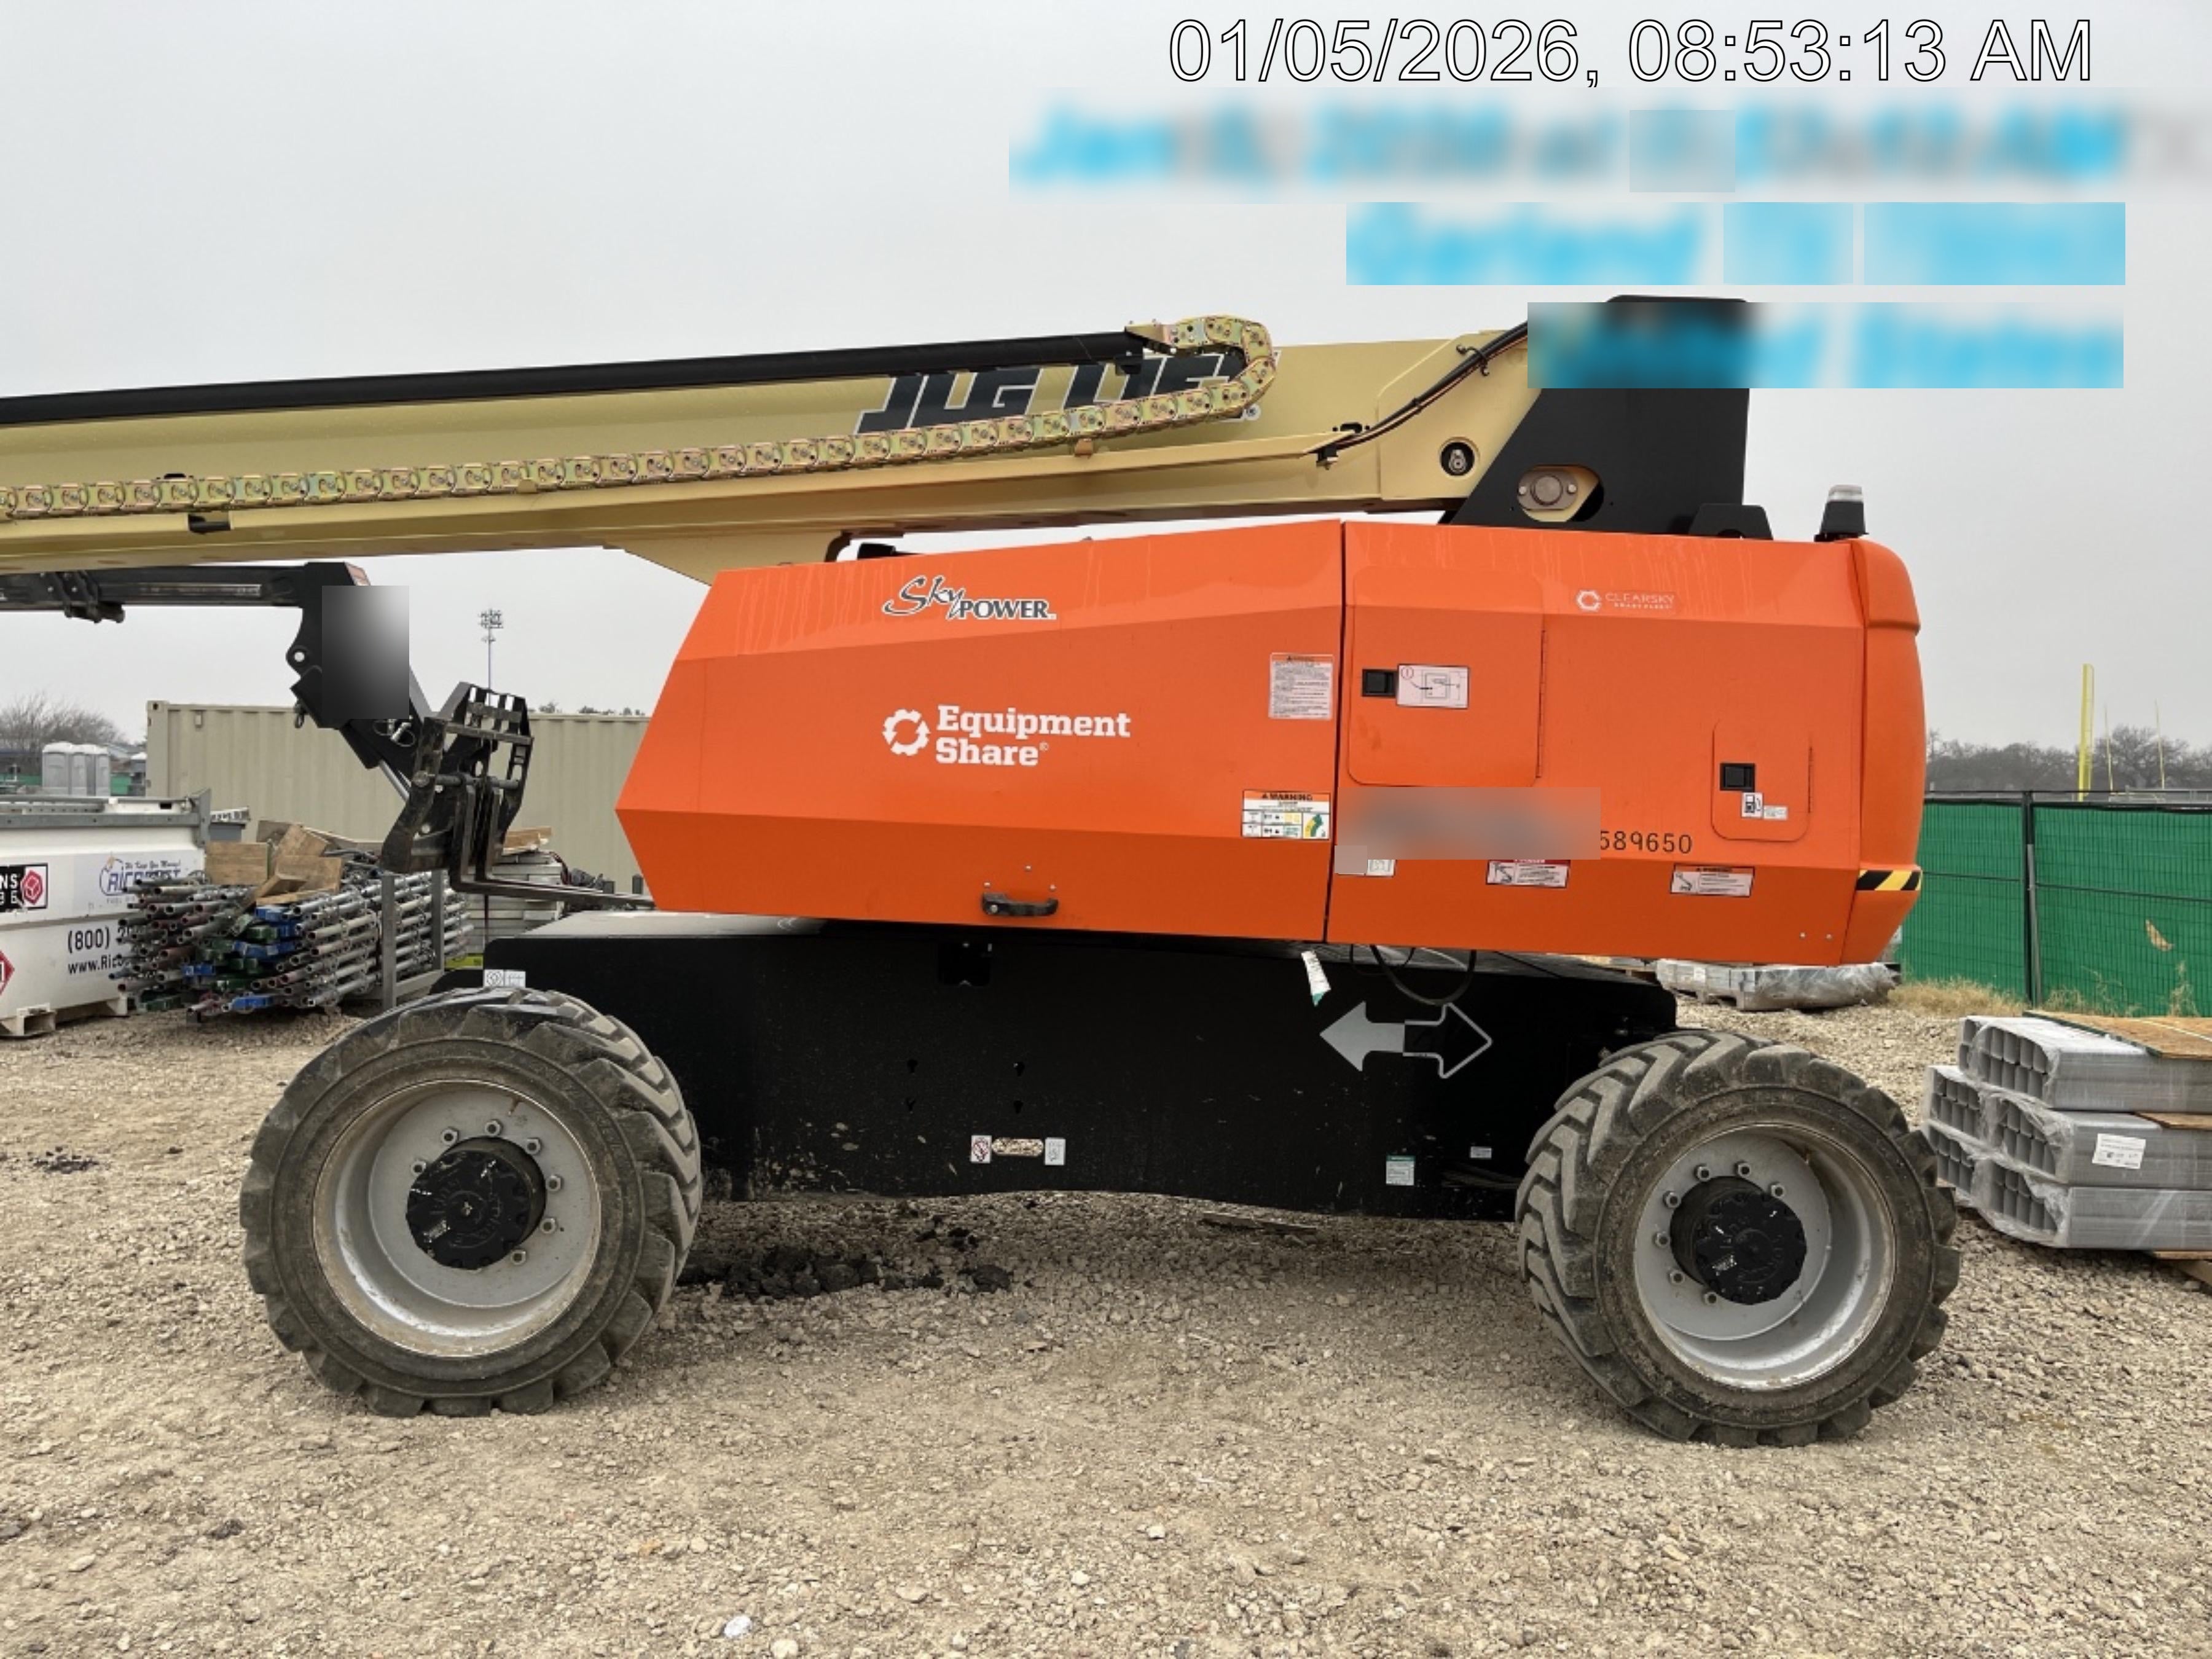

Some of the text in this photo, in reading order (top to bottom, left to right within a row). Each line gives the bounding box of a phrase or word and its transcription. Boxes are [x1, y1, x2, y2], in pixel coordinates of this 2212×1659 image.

[853, 367, 1046, 435] JLG
[936, 704, 1132, 740] Equipment
[68, 927, 110, 953] (800)
